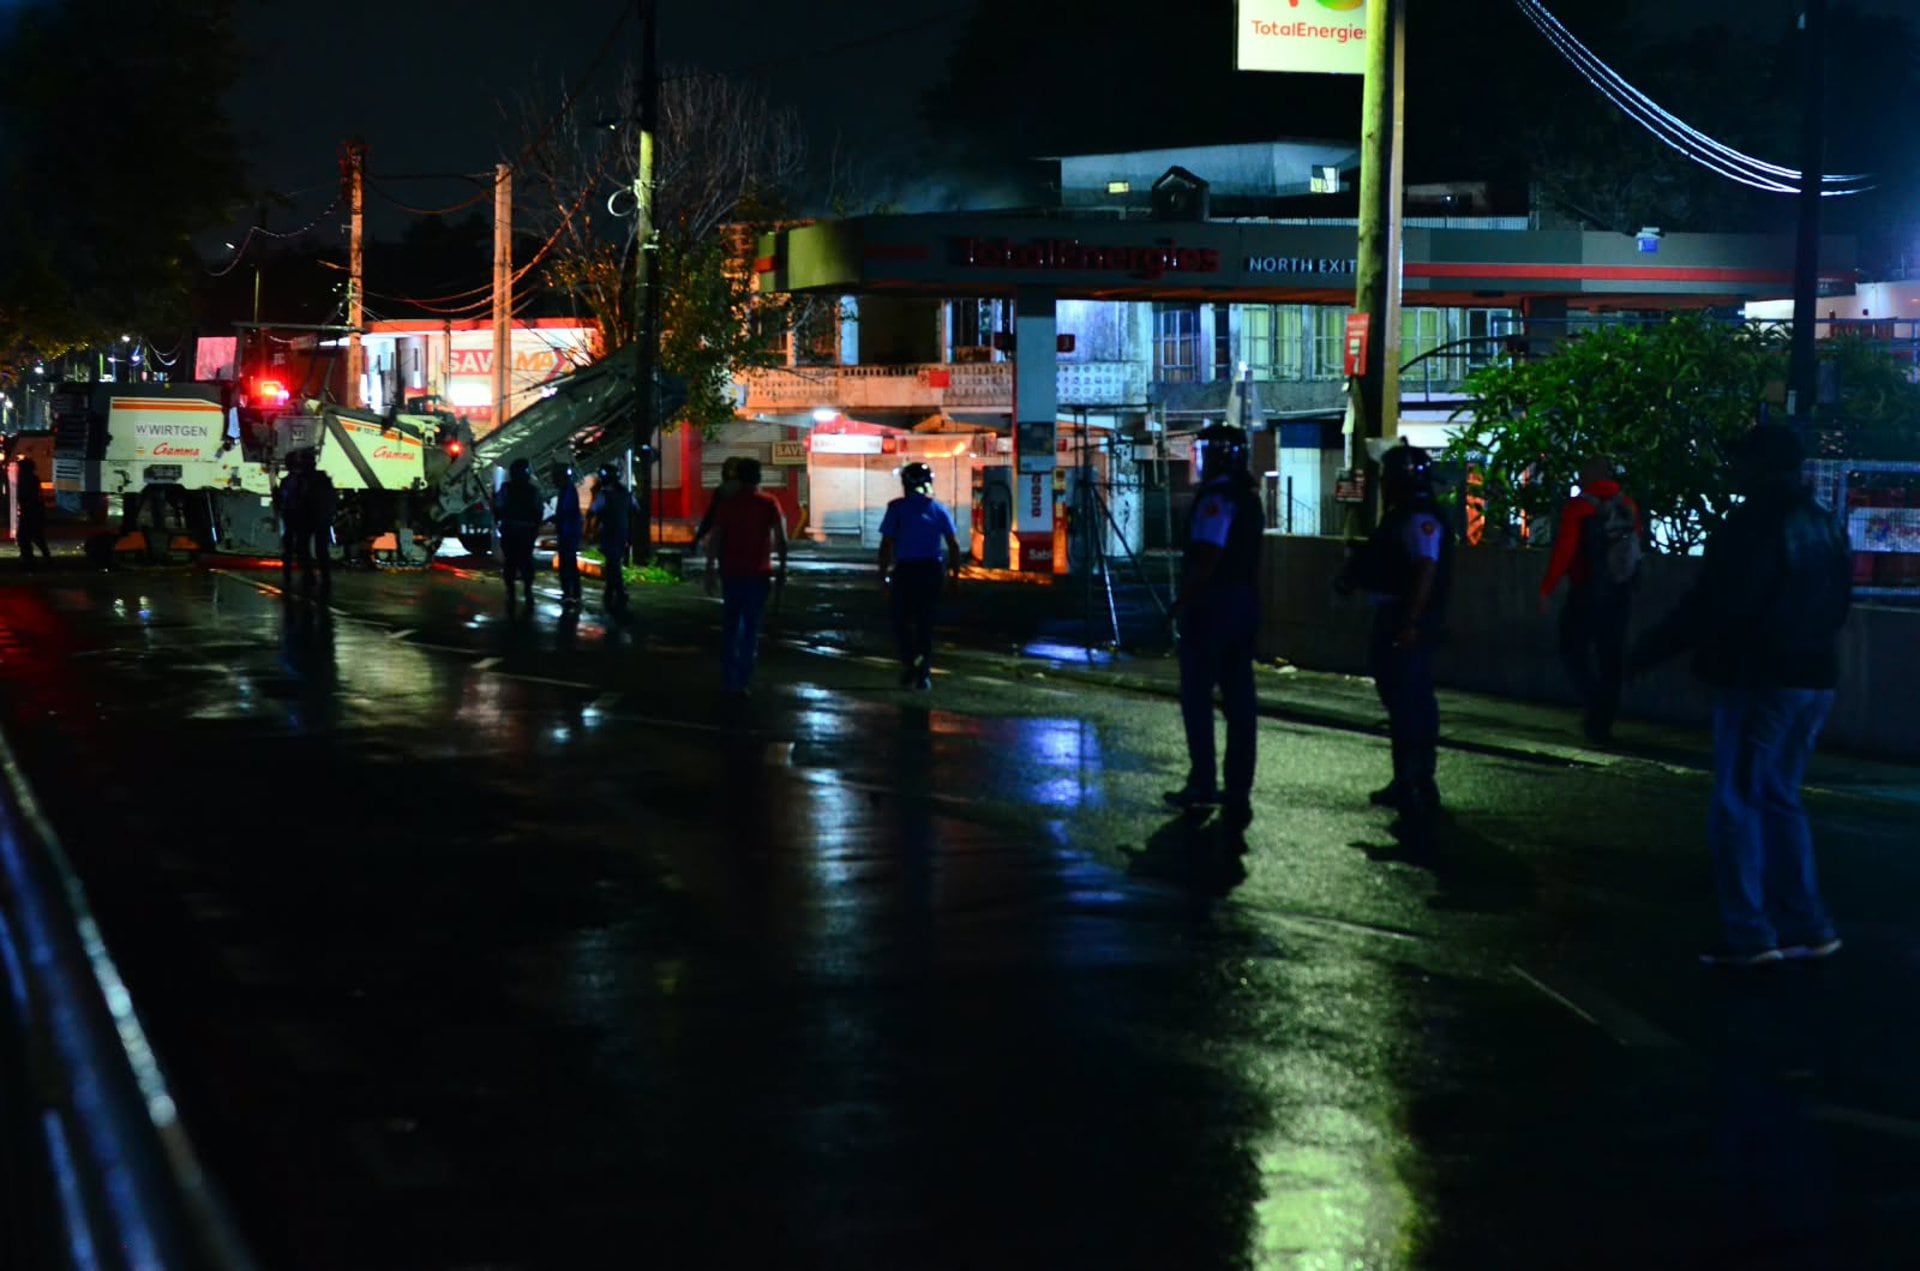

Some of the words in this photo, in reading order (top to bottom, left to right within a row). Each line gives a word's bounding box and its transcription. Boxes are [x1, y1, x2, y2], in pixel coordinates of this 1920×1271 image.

[1248, 256, 1313, 272] NORTH
[1319, 258, 1357, 273] EXIT
[449, 351, 493, 373] SAV
[149, 425, 208, 437] WIRTGEN
